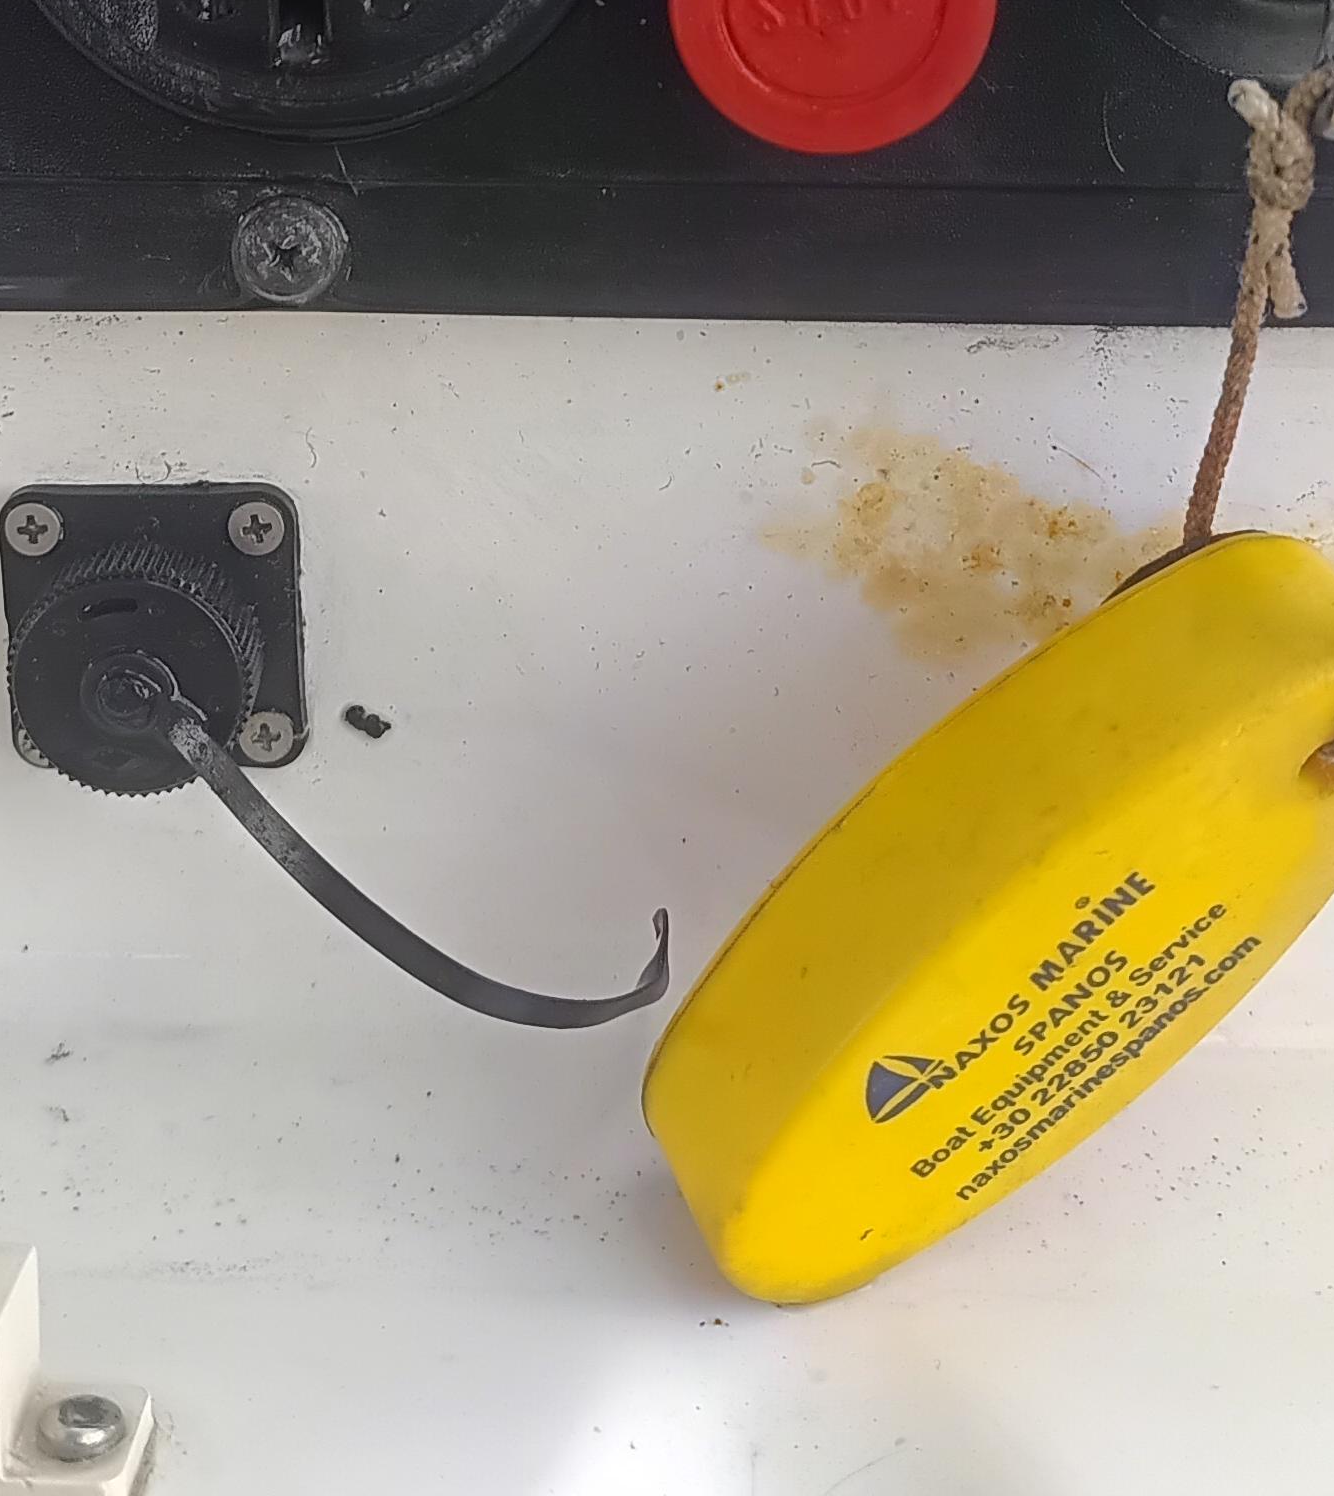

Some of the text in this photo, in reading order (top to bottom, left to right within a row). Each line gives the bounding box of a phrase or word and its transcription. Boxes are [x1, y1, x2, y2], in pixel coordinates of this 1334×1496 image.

[909, 903, 1227, 1178] Boat Equipment & Service
[926, 870, 1156, 1090] NAXOS MARINE
[955, 935, 1262, 1201] naxosmarinespanos.com
[978, 954, 1206, 1152] +30 22850 23121
[1013, 949, 1128, 1056] SPANOS
